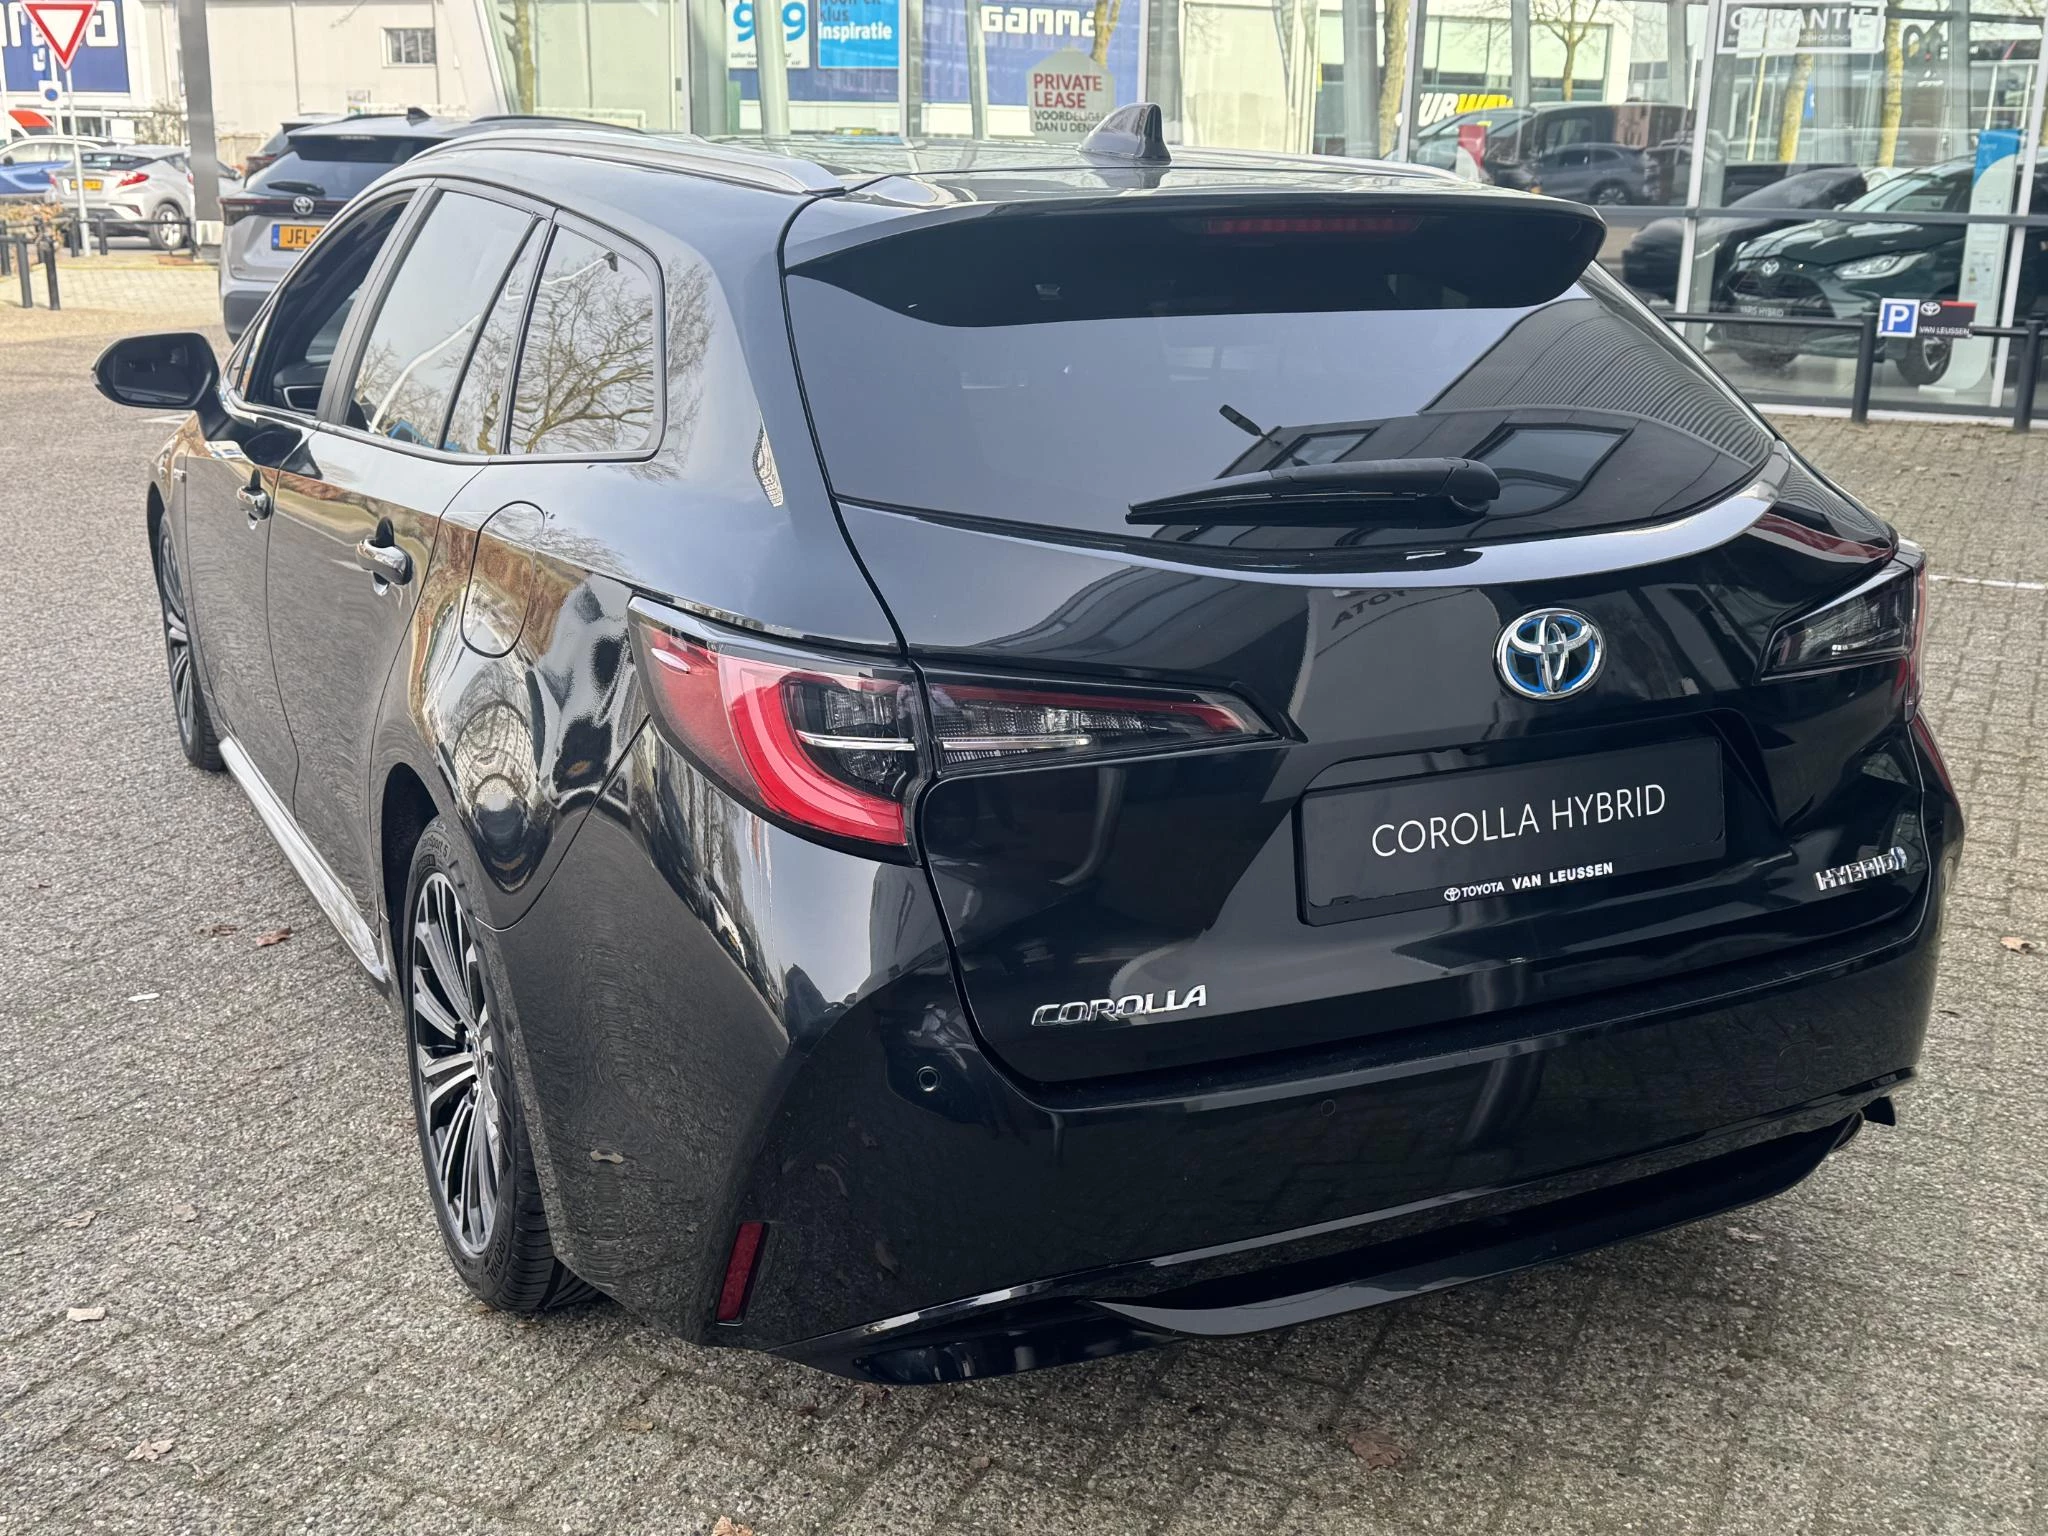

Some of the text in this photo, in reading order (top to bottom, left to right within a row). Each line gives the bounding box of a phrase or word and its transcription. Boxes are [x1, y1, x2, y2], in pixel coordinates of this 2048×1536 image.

[1730, 8, 1873, 30] GARANTIE
[818, 21, 893, 43] inspiratie
[1033, 73, 1103, 91] PRIVATE
[1034, 92, 1086, 109] LEASE
[1035, 121, 1058, 132] DAN
[1060, 122, 1068, 132] U
[1887, 304, 1909, 331] P
[1919, 326, 1970, 335] VAN LEUSSEN
[1372, 785, 1665, 857] COROLLA HYBRID
[1461, 862, 1613, 898] TOYOTA VAN LEUSSEN
[1815, 848, 1906, 891] HYBRID
[1031, 984, 1206, 1027] COROLLA
